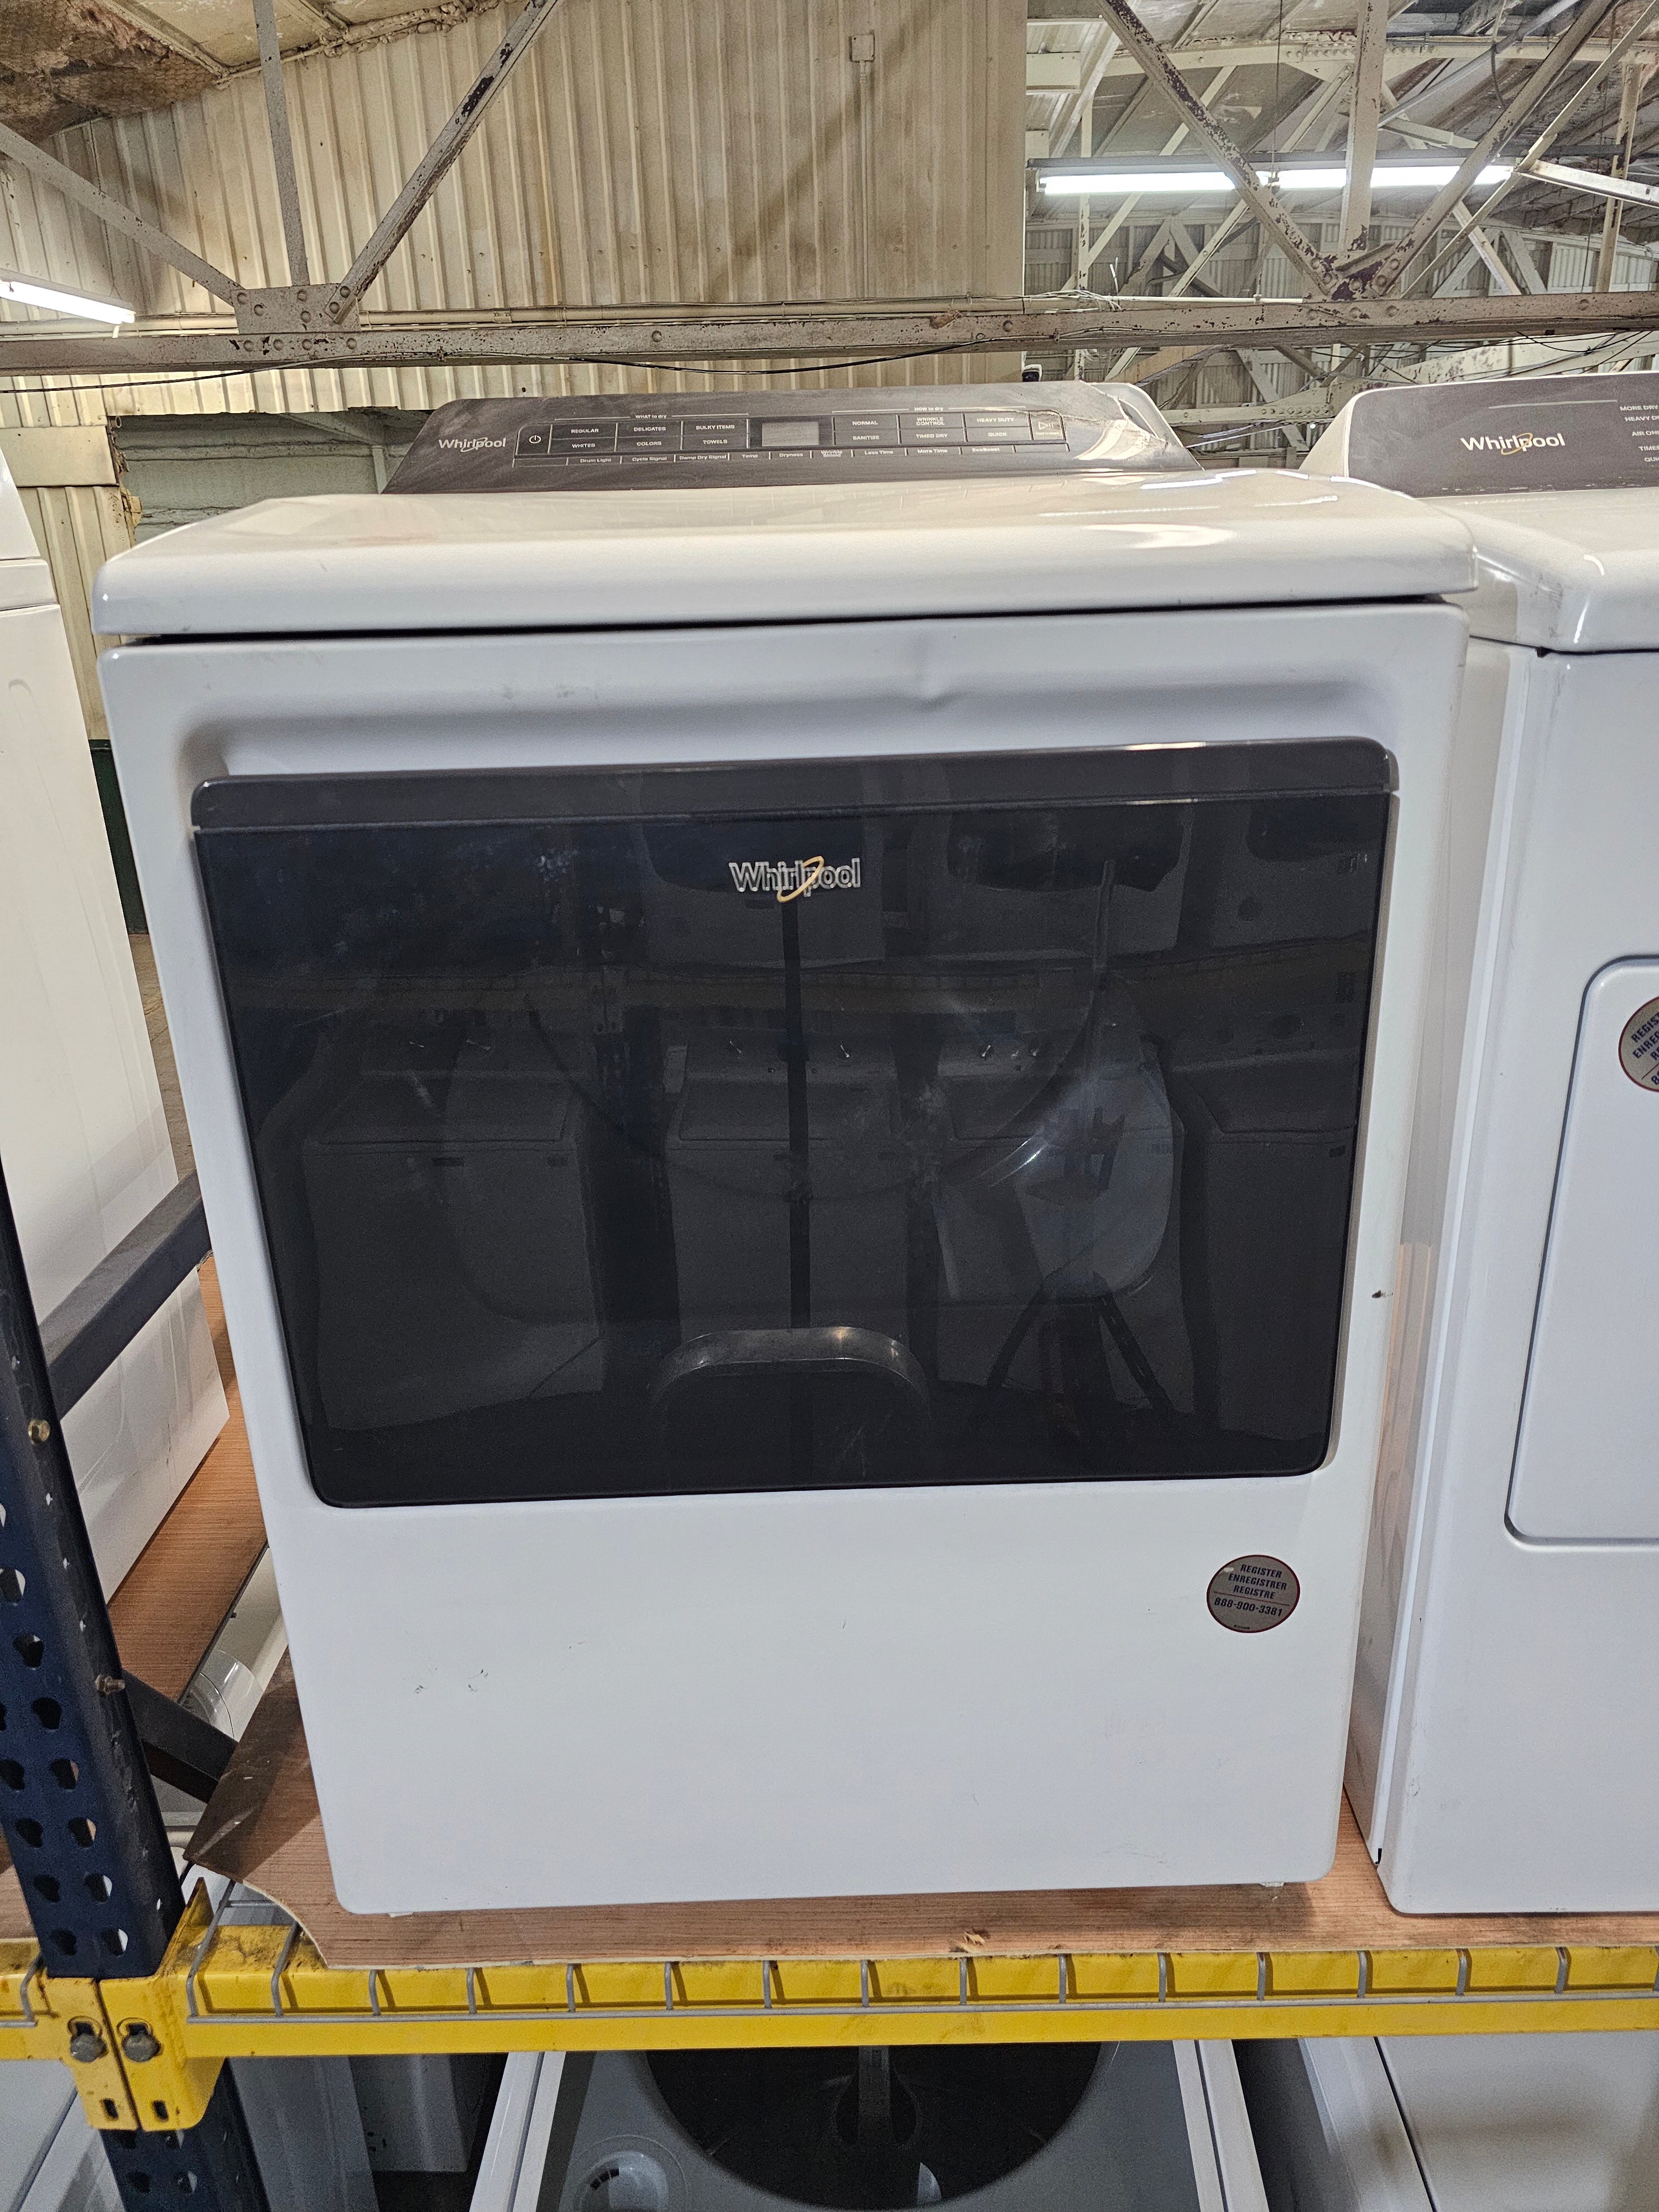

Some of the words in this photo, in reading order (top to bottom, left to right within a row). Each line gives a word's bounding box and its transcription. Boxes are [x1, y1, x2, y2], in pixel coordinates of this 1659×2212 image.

[439, 437, 506, 452] Whirlpool
[1460, 432, 1566, 455] Whirlpool
[728, 855, 861, 903] Whirlpool
[1240, 1564, 1282, 1578] REGISTER
[1228, 1573, 1287, 1590] ENREGISTRER
[1233, 1585, 1275, 1599] REGISTRE
[1214, 1597, 1282, 1616] 888-900-3381
